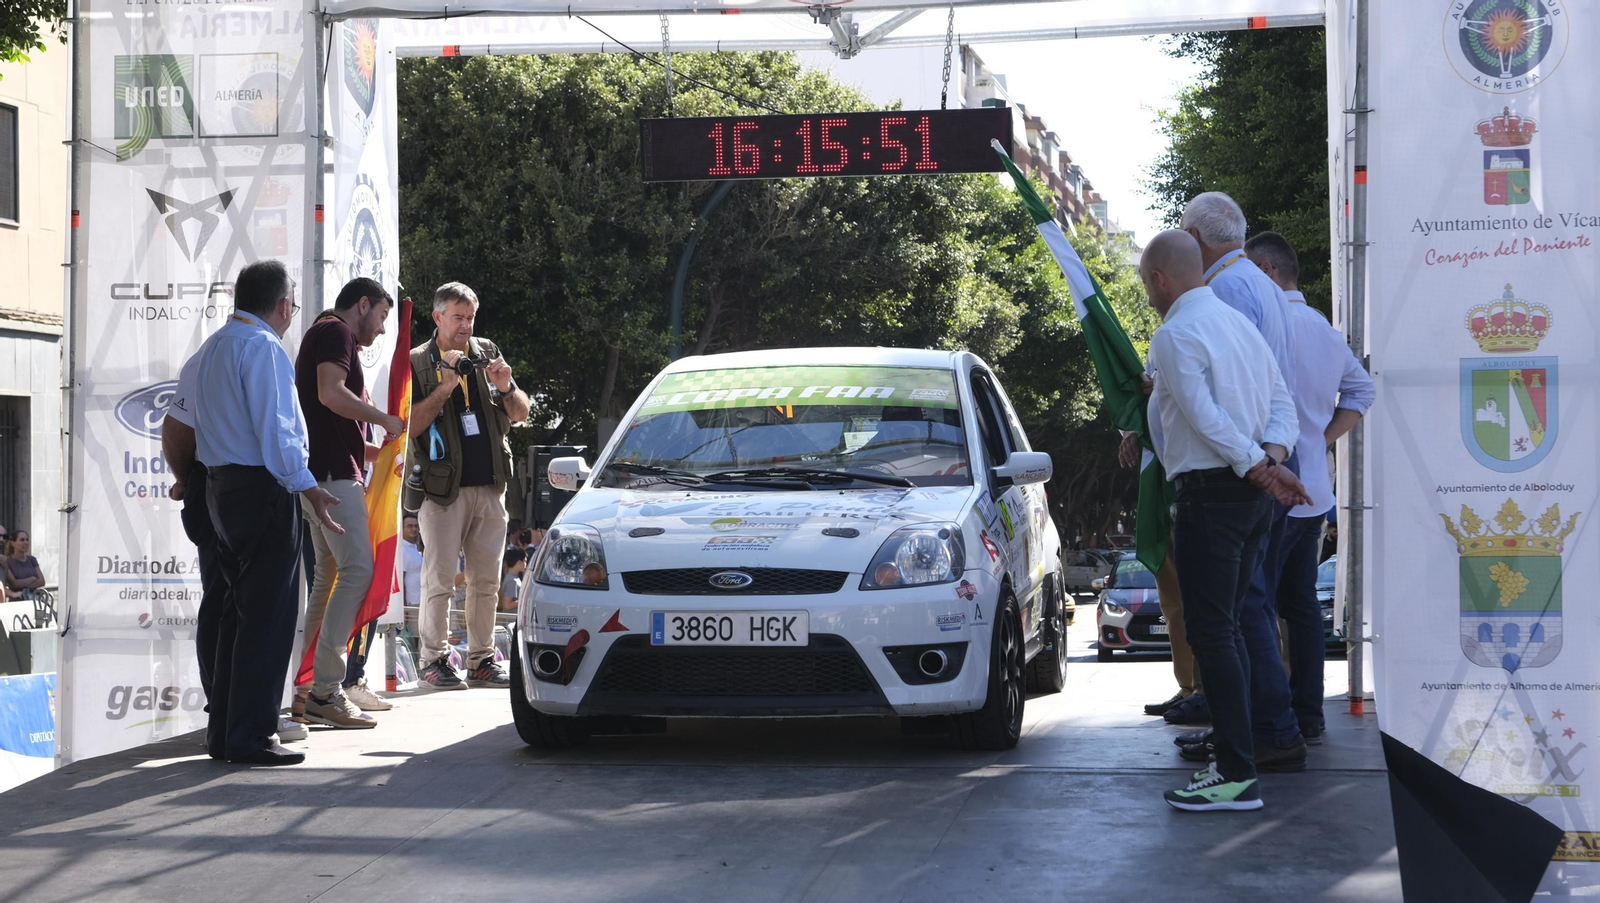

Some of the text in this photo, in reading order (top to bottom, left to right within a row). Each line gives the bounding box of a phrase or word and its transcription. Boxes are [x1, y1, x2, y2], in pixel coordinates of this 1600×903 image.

[1473, 73, 1541, 90] ALMERIA
[214, 87, 263, 102] ALMERÍA
[707, 116, 938, 175] 16:15:51
[1411, 215, 1528, 236] Ayuntamiento
[1533, 213, 1553, 229] de
[1425, 234, 1592, 268] Corazón del Poniente
[1481, 360, 1537, 368] ALBOLODUY
[666, 387, 794, 406] COPA
[798, 385, 896, 399] FAA
[124, 450, 173, 474] Ind
[1436, 482, 1575, 495] Ayuntamiento de Alboloduy
[97, 554, 163, 575] Diario
[164, 555, 187, 575] de
[717, 575, 742, 585] Ford
[157, 617, 199, 626] GRUPO
[671, 616, 734, 641] 3860
[749, 616, 798, 641] HGK
[1421, 681, 1492, 693] Ayuntamiento
[1508, 681, 1548, 691] Alhama
[1549, 681, 1563, 691] de
[1544, 786, 1563, 796] DE
[1567, 786, 1579, 796] TI
